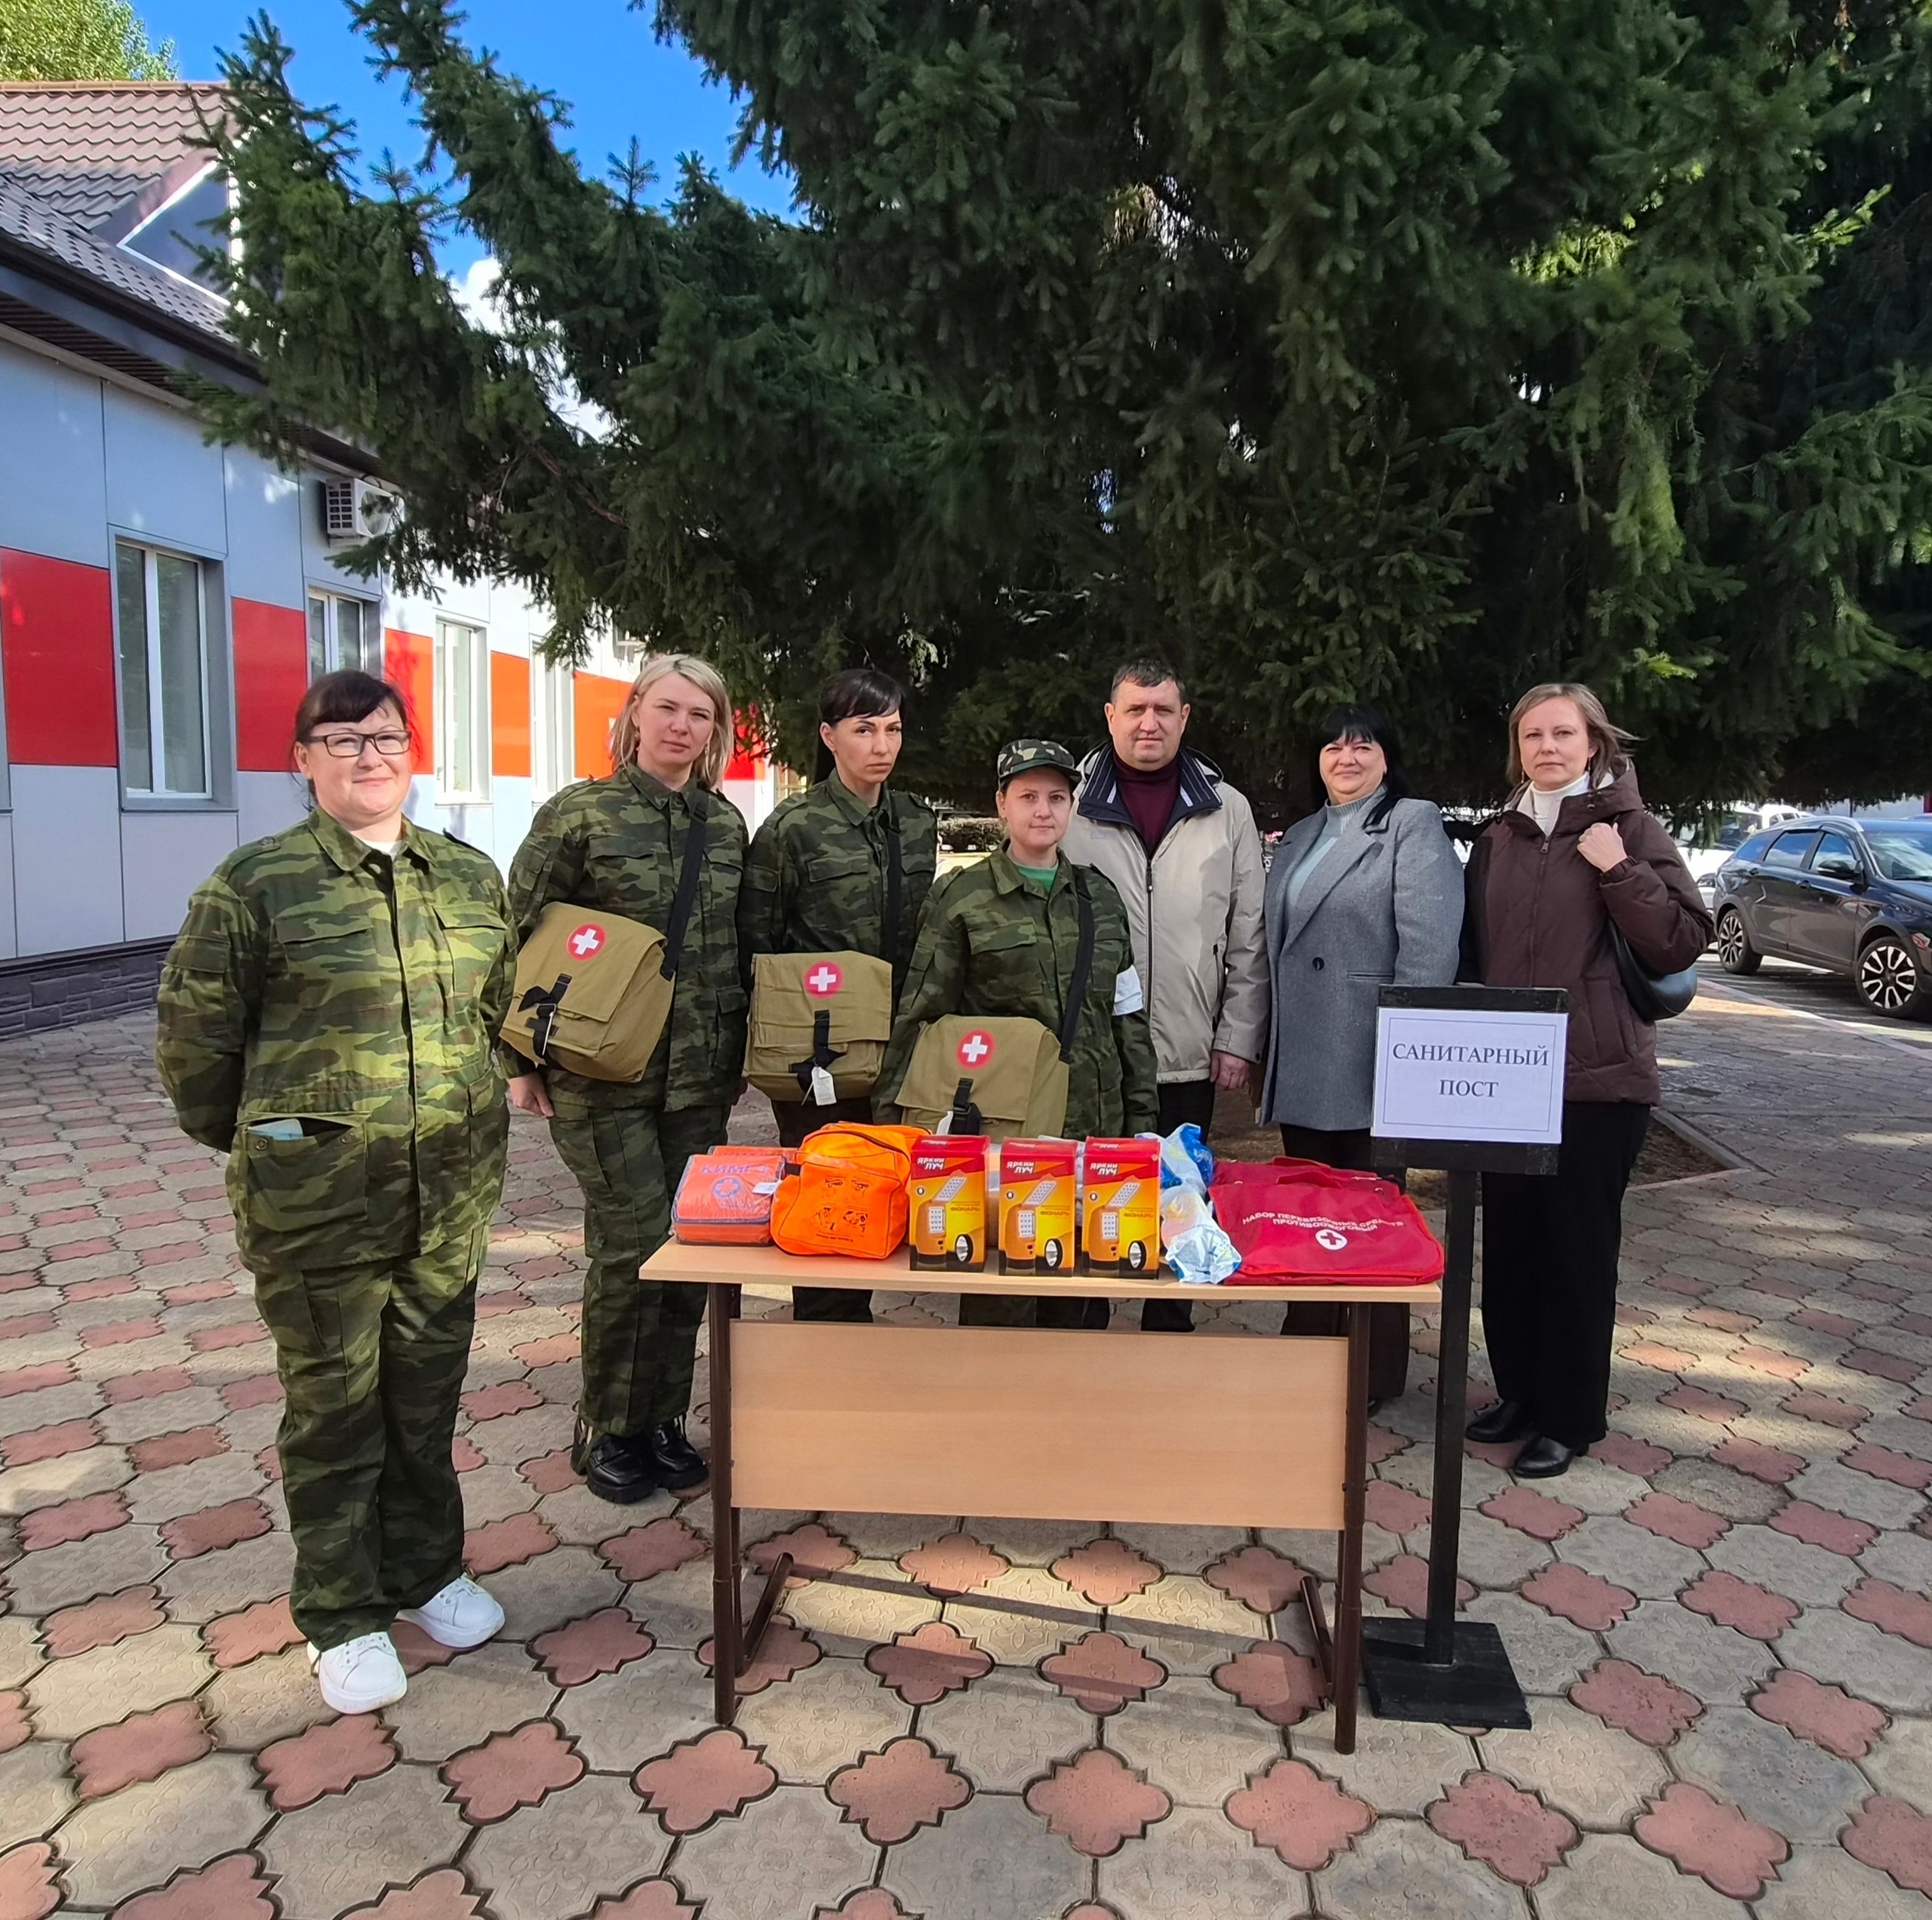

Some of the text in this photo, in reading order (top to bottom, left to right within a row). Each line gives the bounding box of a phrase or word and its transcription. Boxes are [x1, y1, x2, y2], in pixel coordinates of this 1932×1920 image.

[1392, 1043, 1549, 1066] САНИТАРНЫЙ
[1438, 1079, 1499, 1097] ПОСТ
[1097, 1168, 1117, 1176] ЛУЧ
[1242, 1212, 1275, 1225] НАБОР
